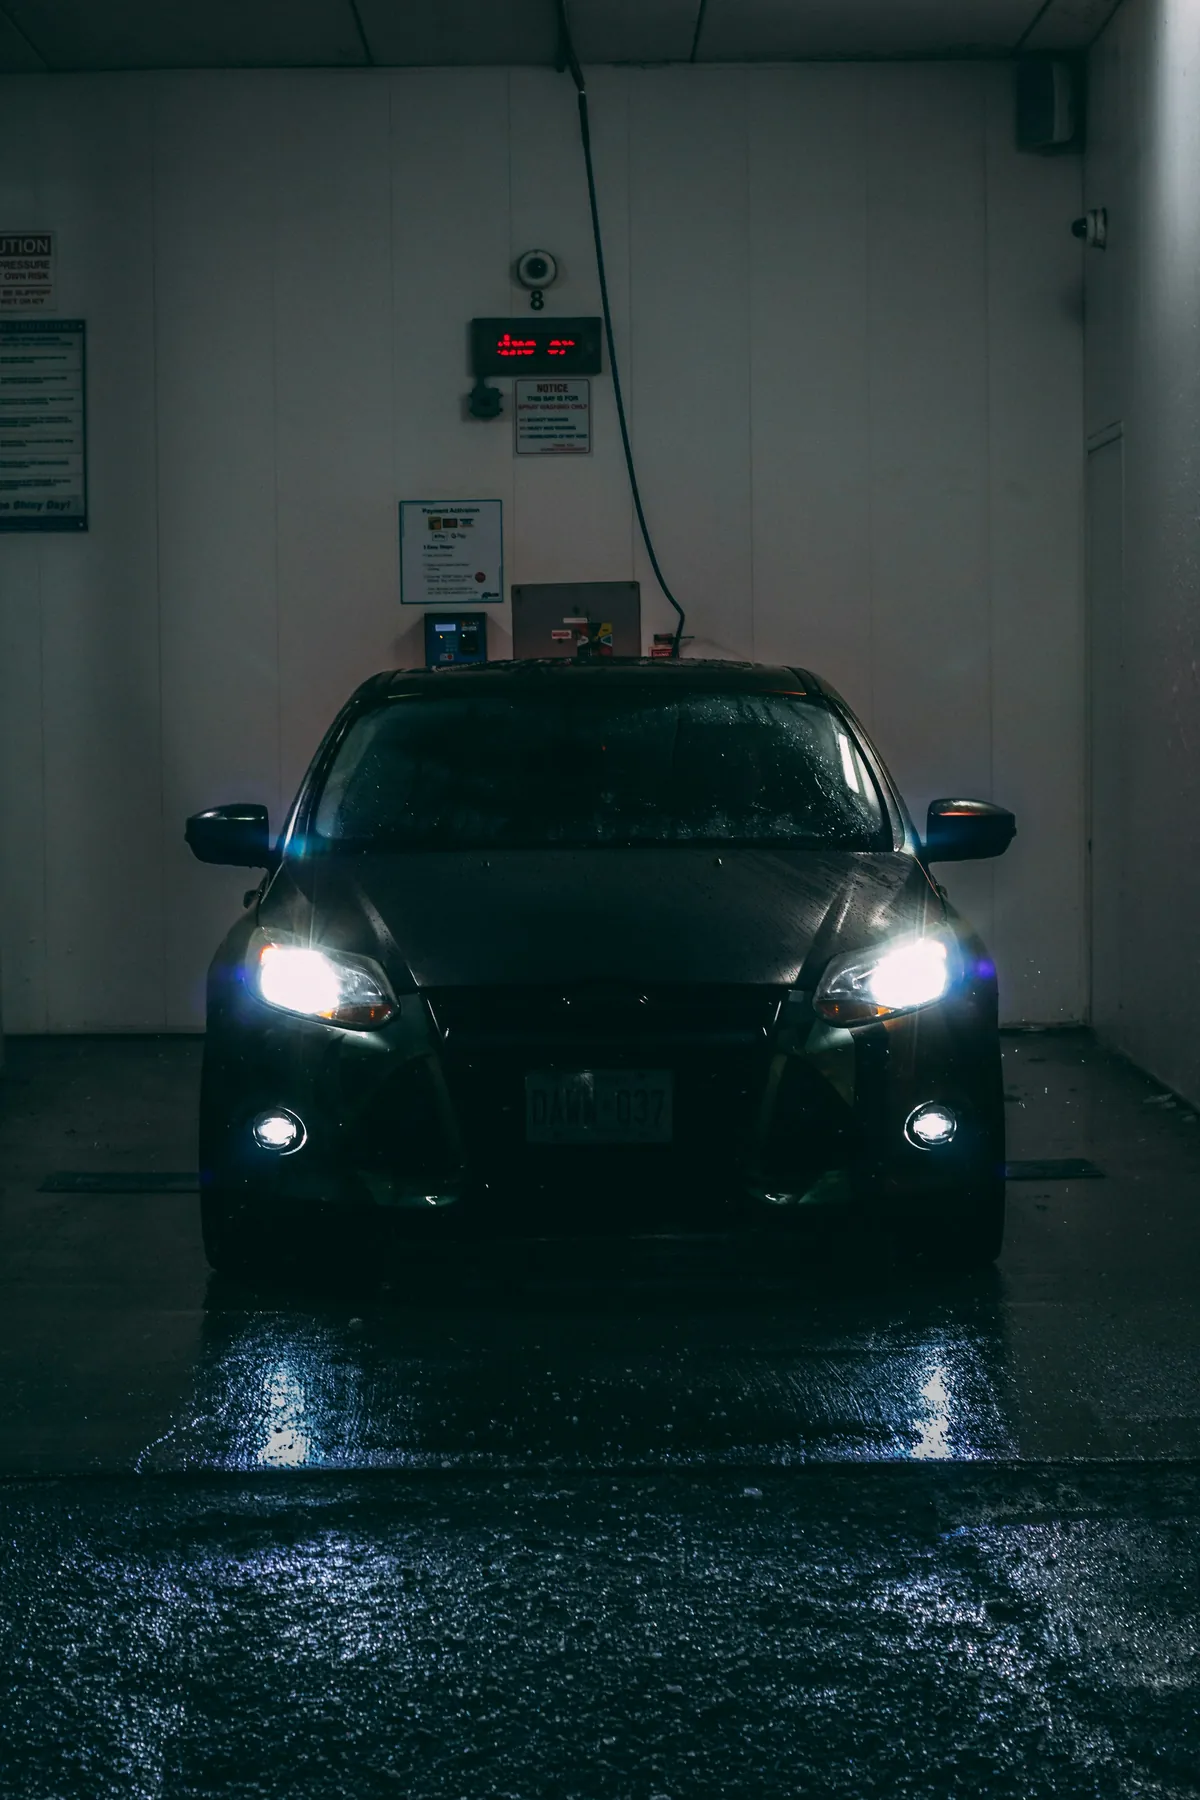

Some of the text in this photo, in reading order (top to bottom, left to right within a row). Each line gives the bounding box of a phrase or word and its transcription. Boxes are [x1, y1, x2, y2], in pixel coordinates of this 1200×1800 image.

[28, 272, 49, 280] RISK
[530, 290, 544, 310] 8
[537, 384, 569, 392] NOTICE
